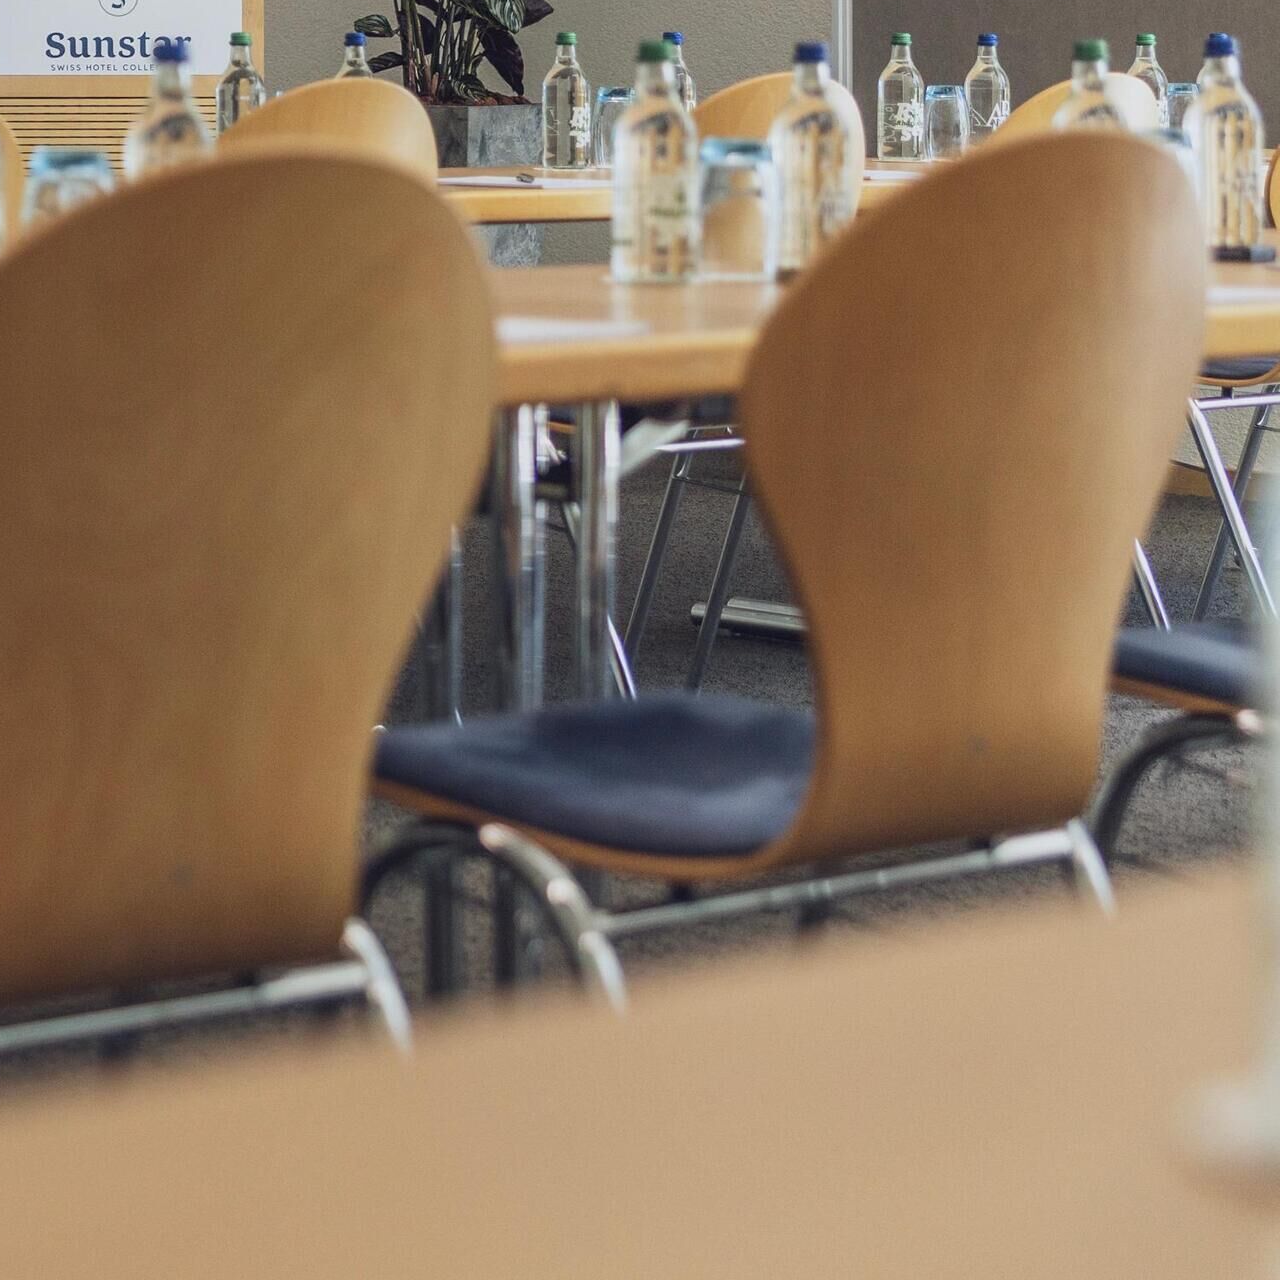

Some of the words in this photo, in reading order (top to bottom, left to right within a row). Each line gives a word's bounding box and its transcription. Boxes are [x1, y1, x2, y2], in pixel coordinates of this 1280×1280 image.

[50, 63, 82, 72] SWISS
[85, 63, 118, 72] HOTEL
[122, 63, 159, 72] COLLE
